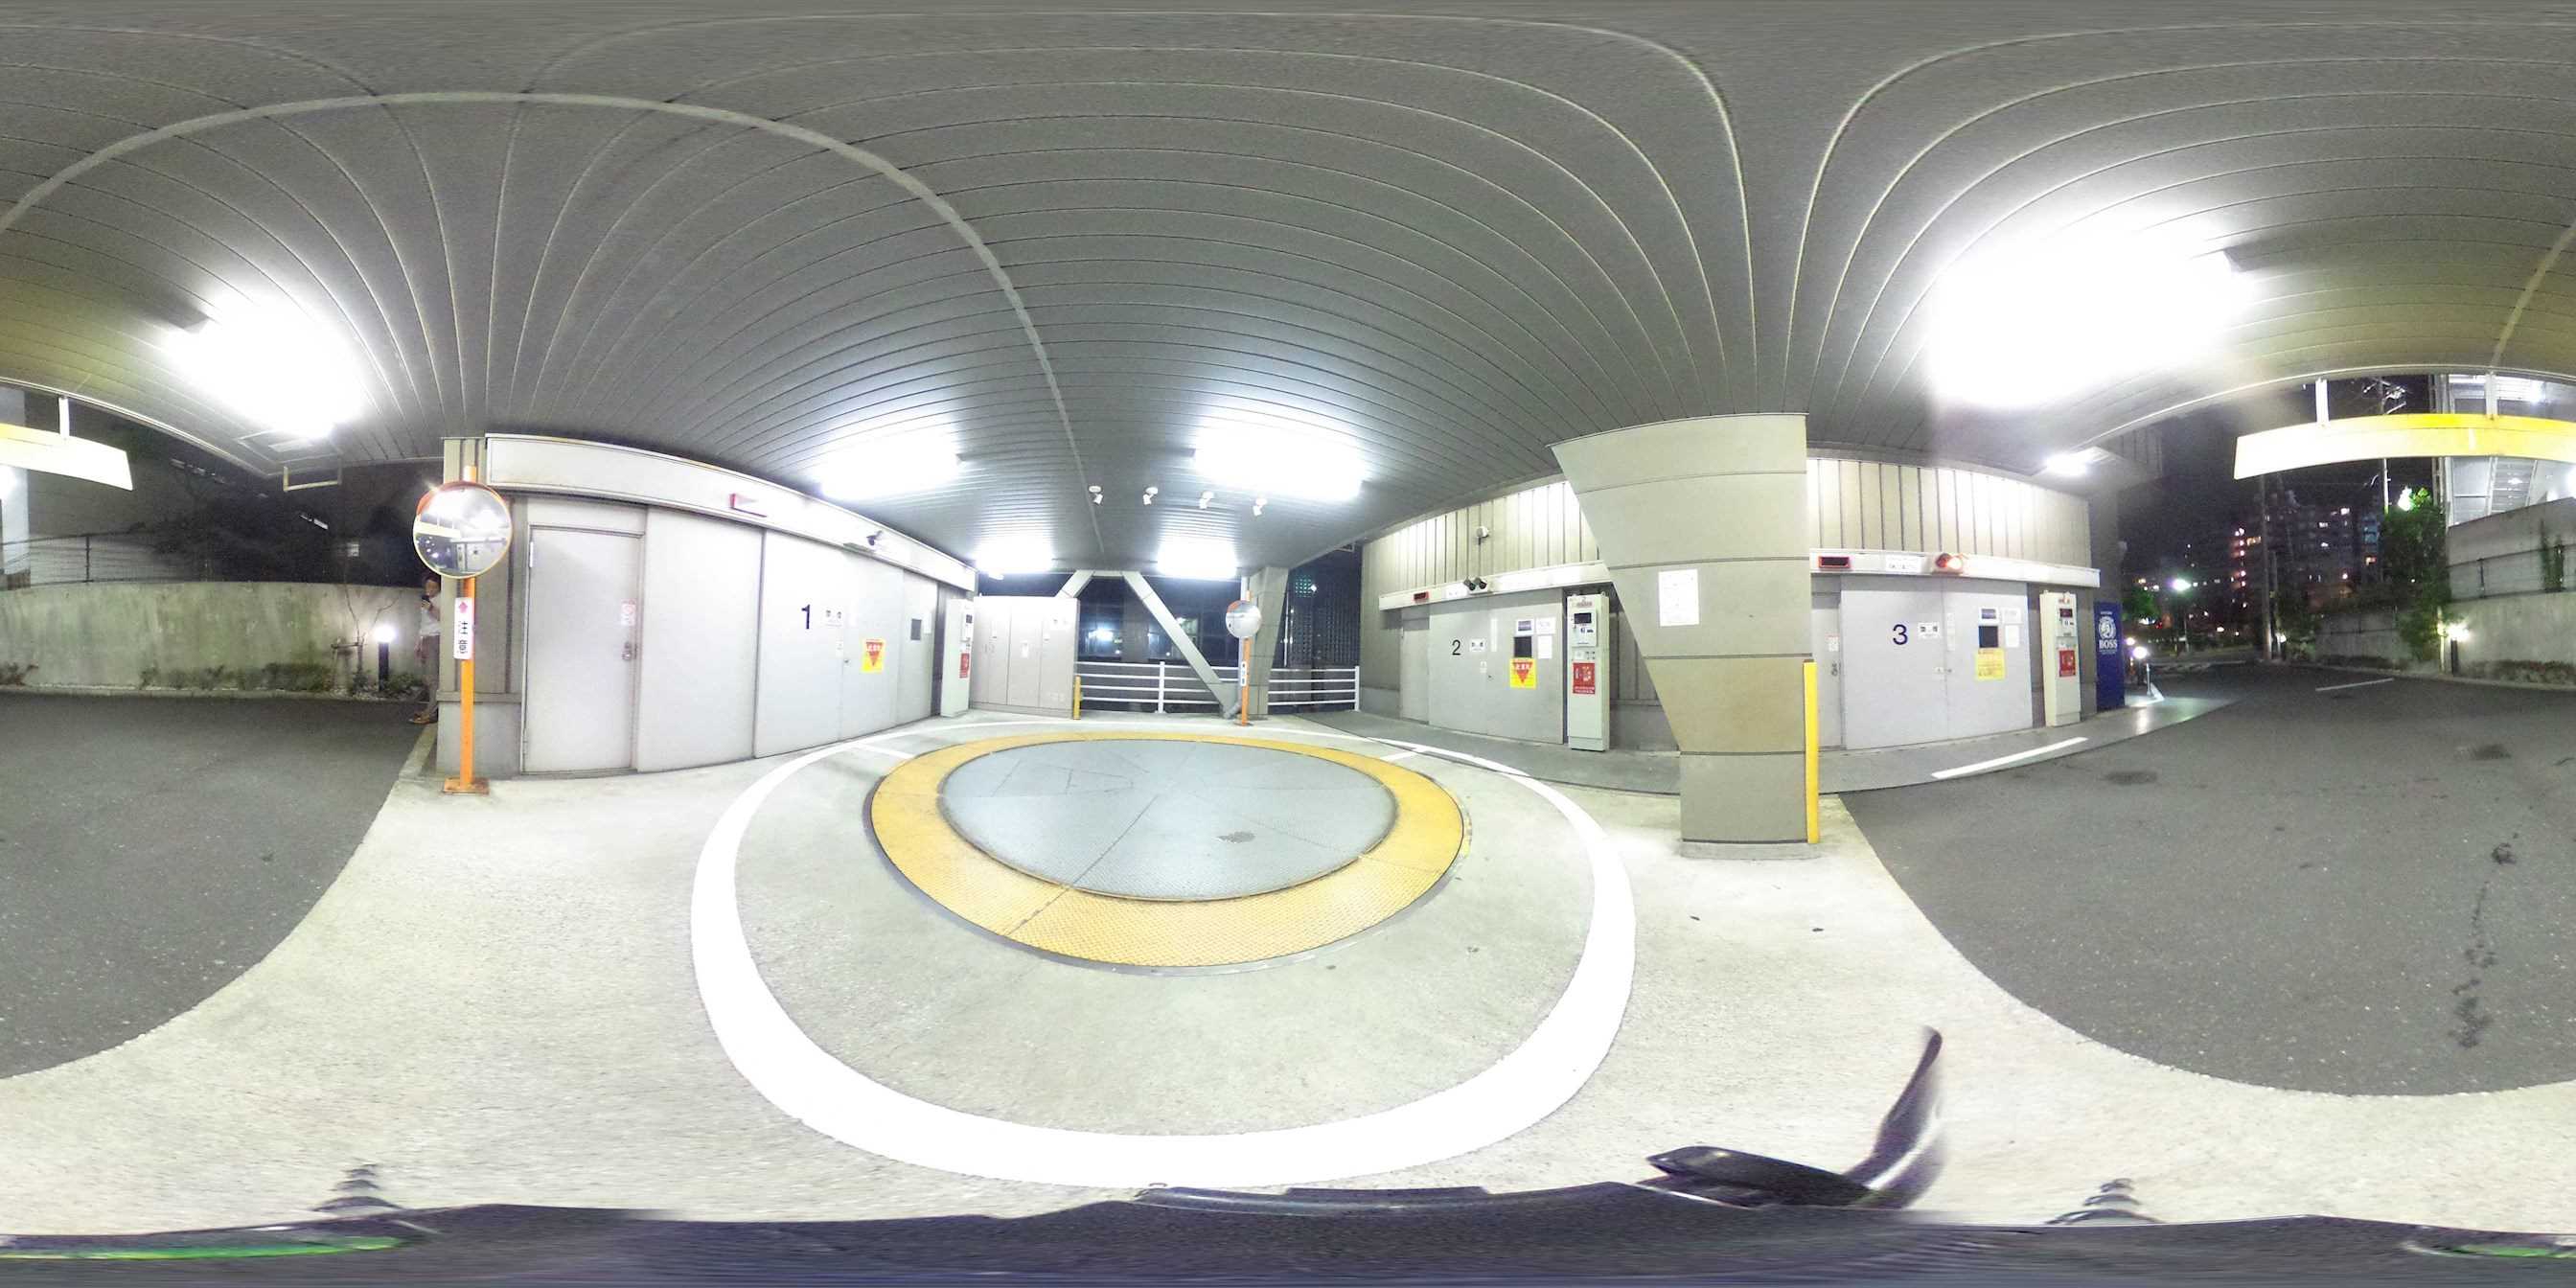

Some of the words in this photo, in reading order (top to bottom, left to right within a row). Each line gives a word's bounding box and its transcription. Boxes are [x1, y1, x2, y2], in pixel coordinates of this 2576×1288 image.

[801, 604, 811, 630] 1
[1893, 624, 1909, 645] 3
[1451, 639, 1461, 656] 2
[2099, 639, 2117, 650] BOSS
